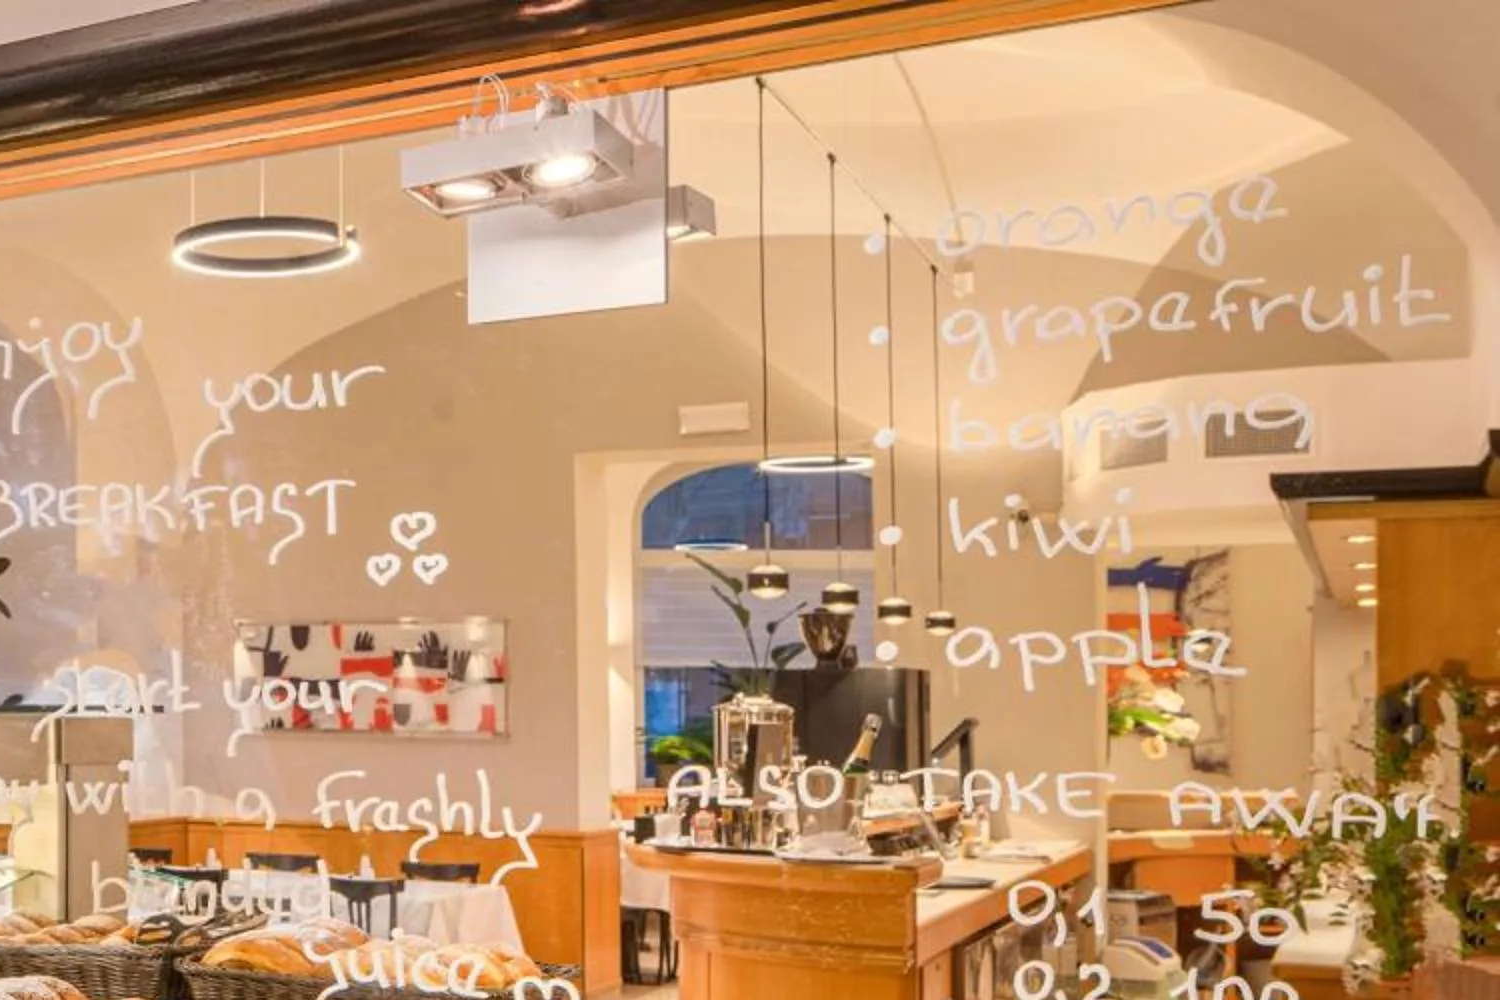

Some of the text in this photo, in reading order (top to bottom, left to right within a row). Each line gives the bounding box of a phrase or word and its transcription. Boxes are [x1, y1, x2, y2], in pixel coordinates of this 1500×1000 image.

[934, 173, 1288, 266] orange
[941, 254, 1452, 383] grapefruit
[193, 364, 386, 477] your
[949, 391, 1316, 453] banana
[948, 487, 1134, 559] kiwi
[945, 581, 1248, 692] apple
[30, 649, 387, 758] start your
[66, 758, 205, 819] with
[235, 787, 276, 831] a
[666, 763, 1443, 841] ALSO TAKE AWAY
[1008, 879, 1298, 948] 0,1 50
